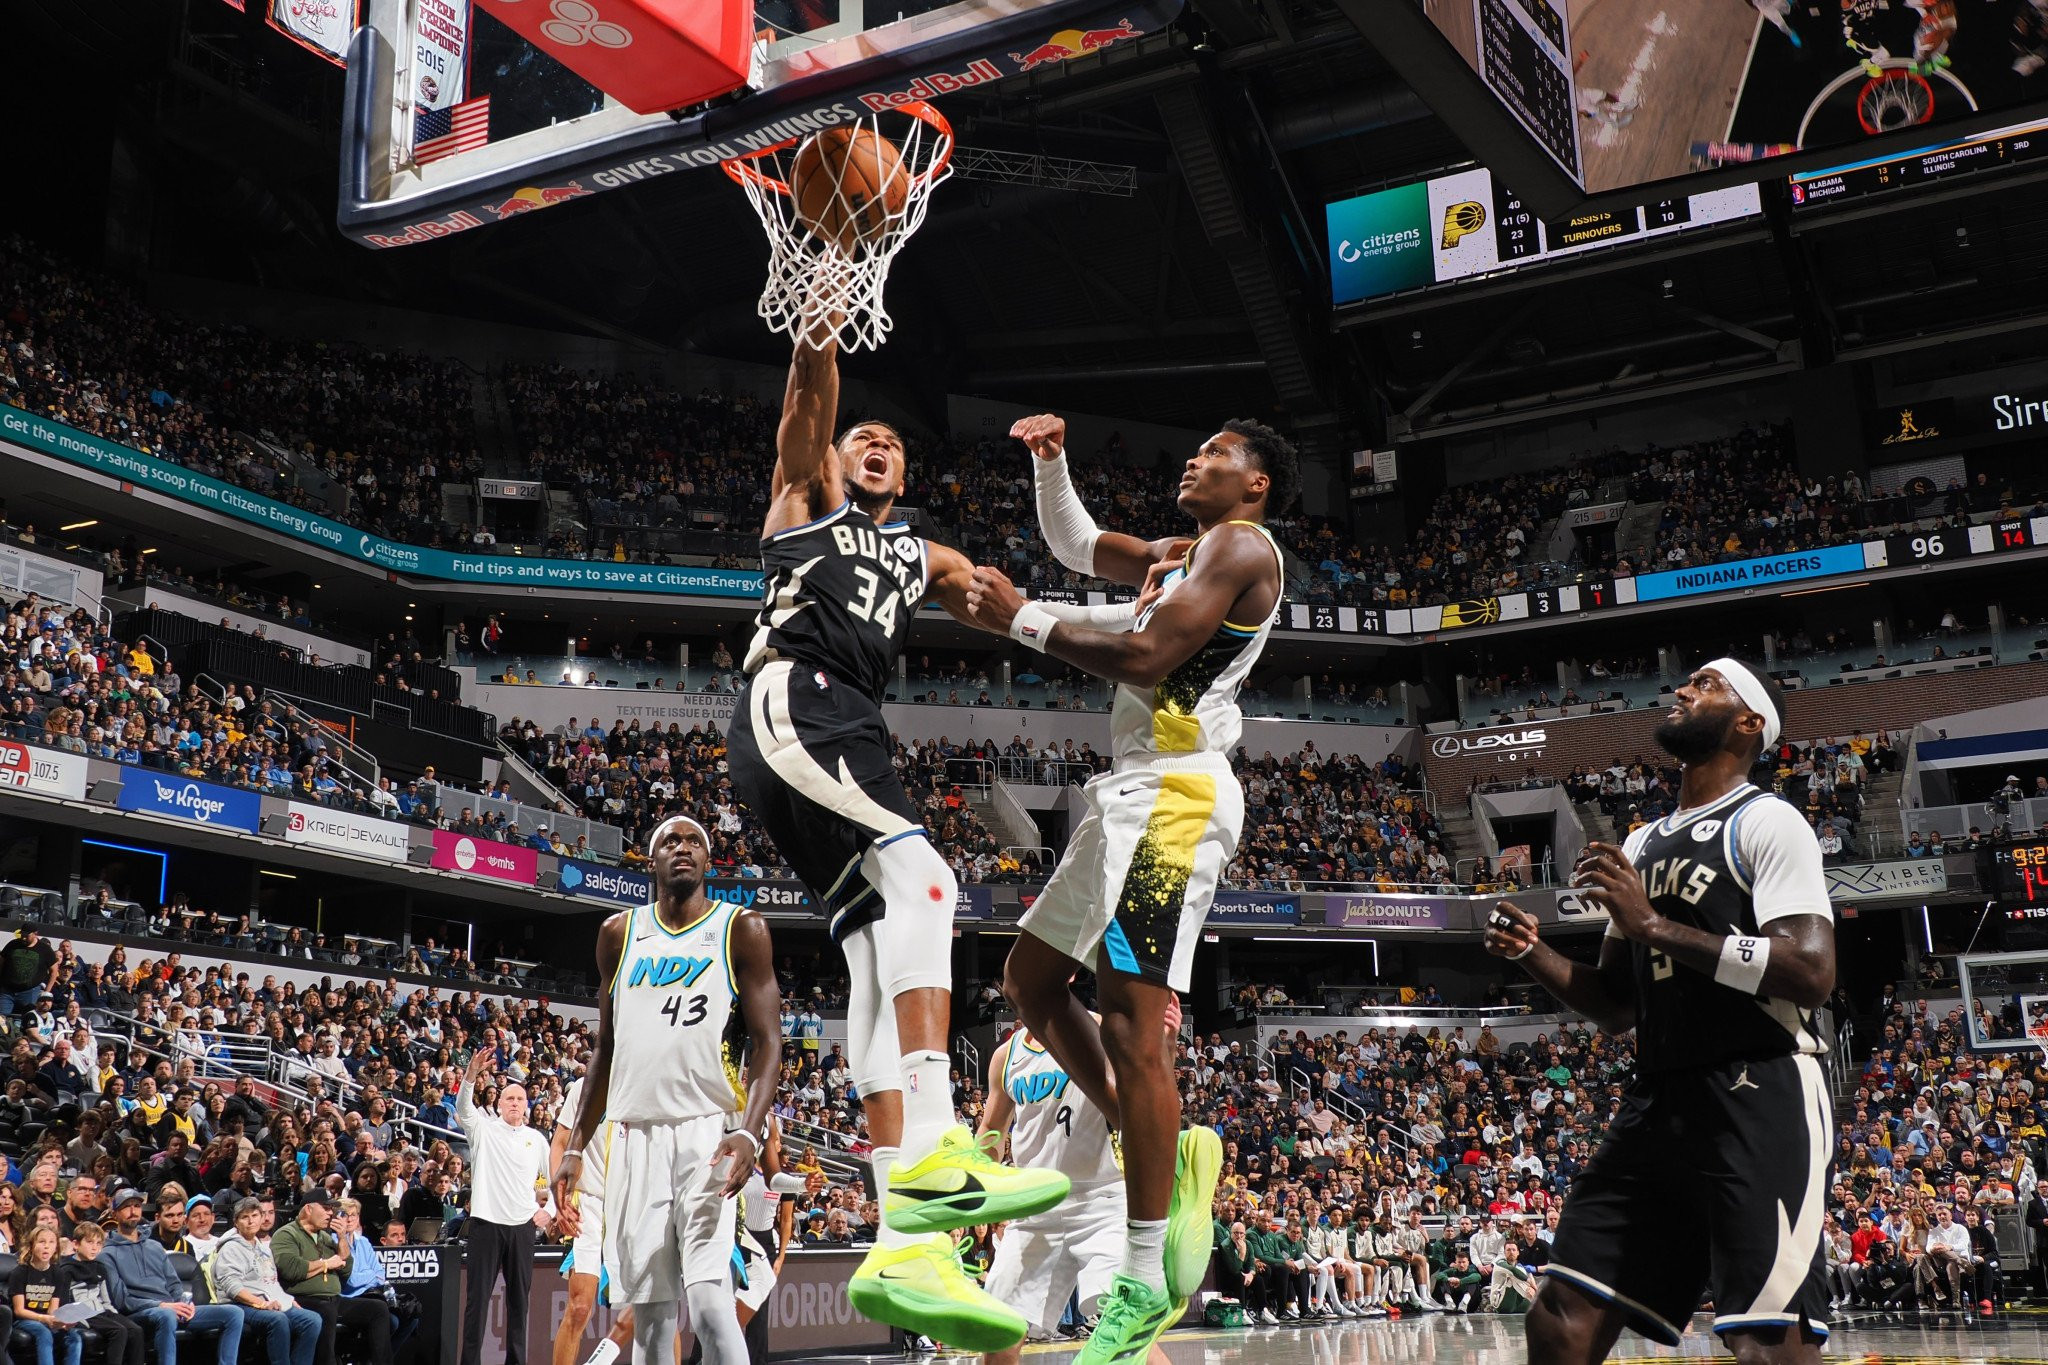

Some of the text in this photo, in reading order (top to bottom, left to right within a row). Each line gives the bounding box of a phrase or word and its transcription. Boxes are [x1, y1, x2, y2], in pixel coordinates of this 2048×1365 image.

[417, 45, 445, 75] 2015
[858, 58, 1004, 114] Red Bull
[2013, 140, 2030, 150] 3RD
[1922, 145, 1988, 166] SOUTH CAROLINA
[1998, 150, 2004, 158] 7
[592, 155, 675, 189] GIVES
[673, 136, 739, 176] YOU
[1923, 161, 1956, 175] ILLINOIS
[1878, 167, 1888, 176] 13
[1900, 166, 1906, 175] F
[1808, 177, 1843, 190] ALABAMA
[1879, 175, 1889, 184] 19
[1809, 185, 1846, 199] MICHIGAN
[1508, 200, 1521, 210] 40
[1502, 212, 1530, 226] 41 (5)
[1661, 211, 1675, 222] 10
[363, 210, 484, 250] Red Bull
[1511, 230, 1524, 239] 23
[1562, 223, 1622, 244] TURNOVERS
[1361, 226, 1420, 250] citizens
[1363, 238, 1421, 259] energy group
[1513, 244, 1525, 255] 11
[3, 412, 344, 545] Get the money-saving scoop from Citizens Energy Group
[484, 483, 498, 494] 211
[520, 486, 537, 497] 212
[900, 511, 916, 523] 213
[1574, 512, 1590, 524] 215
[2000, 522, 2021, 531] SHOT
[2002, 530, 2025, 547] 14
[374, 542, 420, 562] citizens
[1911, 535, 1945, 558] 96
[375, 553, 420, 570] energy group
[831, 525, 923, 607] BUCKS
[452, 559, 484, 574] Find
[487, 559, 511, 578] tips
[517, 562, 544, 577] and
[547, 565, 582, 581] ways
[586, 566, 600, 581] to
[604, 568, 636, 583] save
[638, 569, 653, 584] at
[1675, 556, 1822, 591] INDIANA PACERS
[1590, 583, 1603, 591] FLS
[847, 565, 901, 640] 34
[1593, 591, 1602, 605] 1
[1539, 600, 1549, 613] 3
[1315, 615, 1334, 629] 23
[1363, 618, 1379, 631] 41
[683, 695, 713, 706] NEED
[616, 704, 711, 719] TEXT THE ISSUE &
[969, 713, 974, 725] 7
[1021, 716, 1027, 727] 8
[1463, 729, 1547, 750] LEXUS
[1497, 750, 1542, 762] LOFT
[33, 761, 59, 781] 107.5
[176, 784, 225, 822] Kroger
[307, 820, 346, 837] KRIEG
[497, 856, 515, 871] mhs
[1873, 864, 1944, 883] XIBER
[585, 872, 647, 898] salesforce
[1884, 876, 1944, 891] INTERNET
[1212, 902, 1294, 914] Sports Tech HQ
[1342, 900, 1432, 923] Jack's DONUTS
[627, 955, 716, 989] INDY
[659, 993, 710, 1028] 43
[1908, 1001, 1917, 1015] 11
[1187, 1024, 1192, 1037] 8
[1259, 1025, 1264, 1038] 9
[1012, 1068, 1071, 1106] INDY
[1056, 1105, 1072, 1138] 9
[385, 1262, 440, 1278] BOLD
